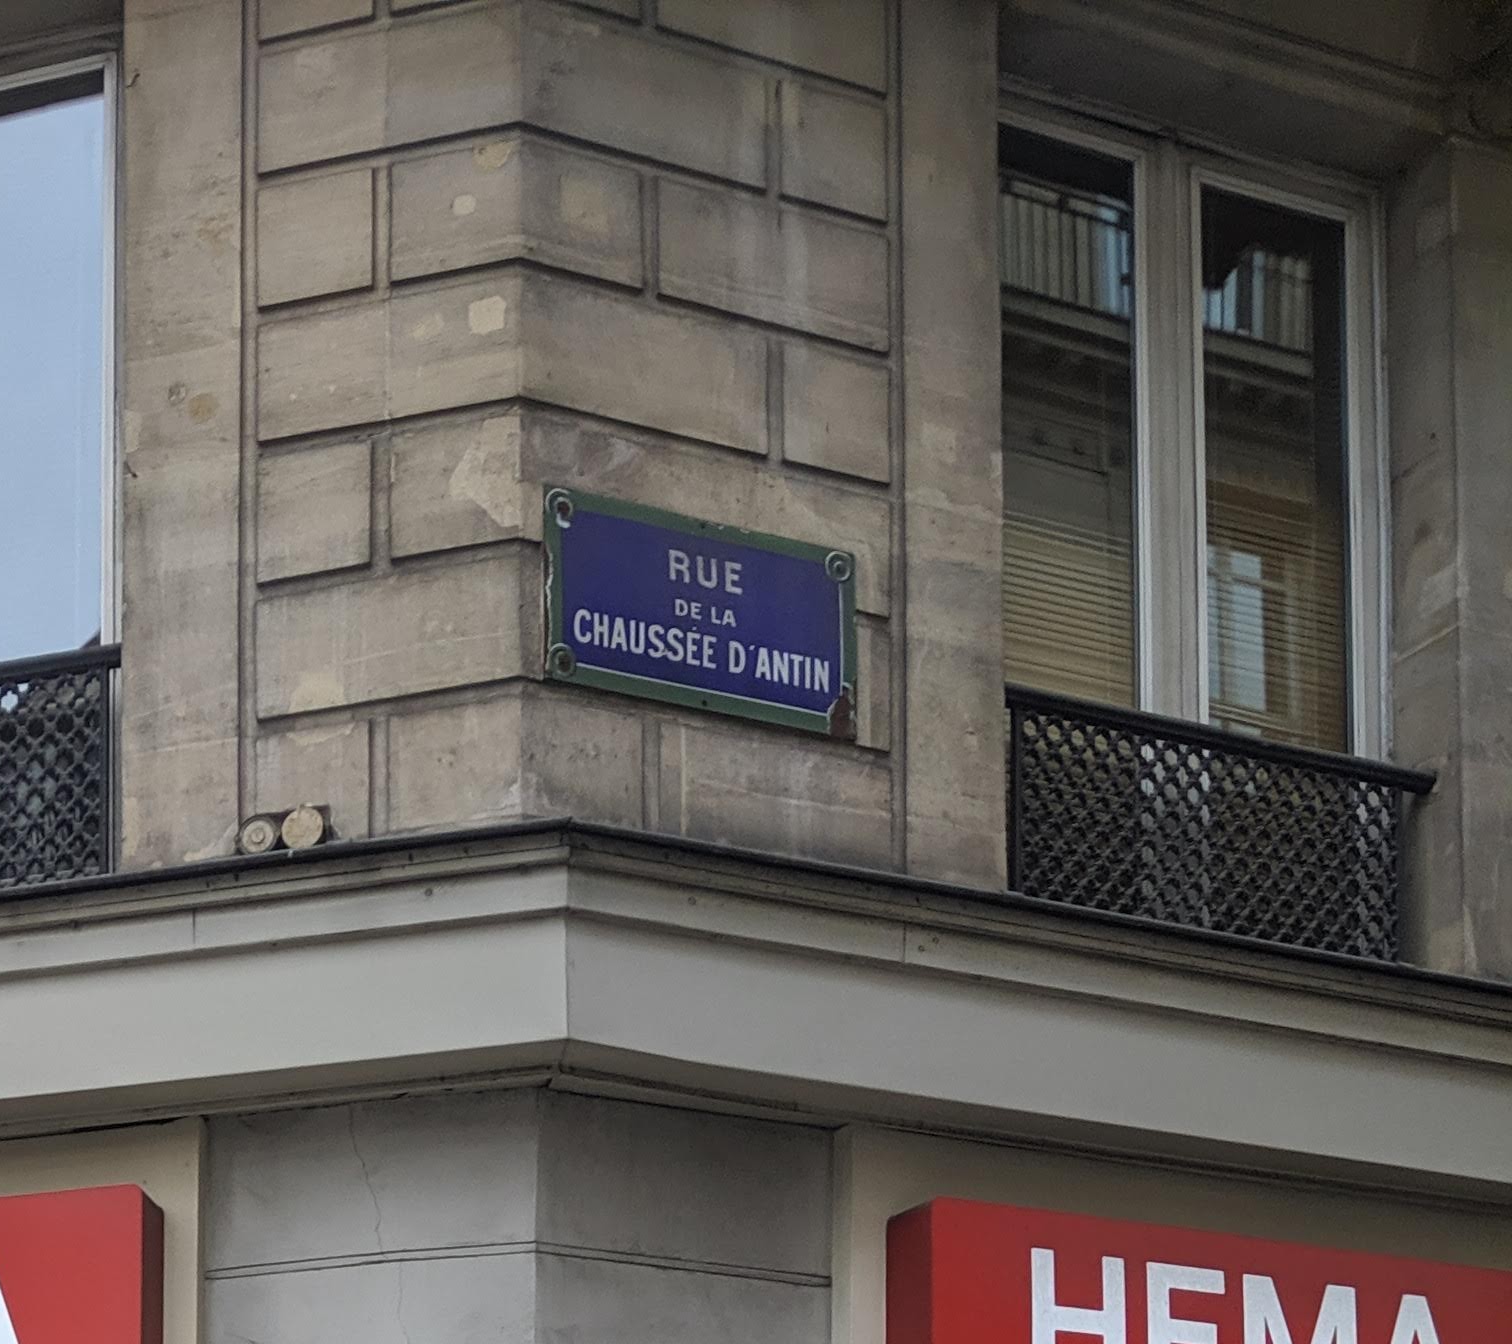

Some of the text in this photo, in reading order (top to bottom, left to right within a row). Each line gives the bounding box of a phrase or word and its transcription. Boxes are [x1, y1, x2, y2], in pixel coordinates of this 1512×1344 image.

[668, 548, 743, 595] RUE
[674, 598, 737, 627] DE LA
[573, 608, 716, 669] CHAUSSÉE
